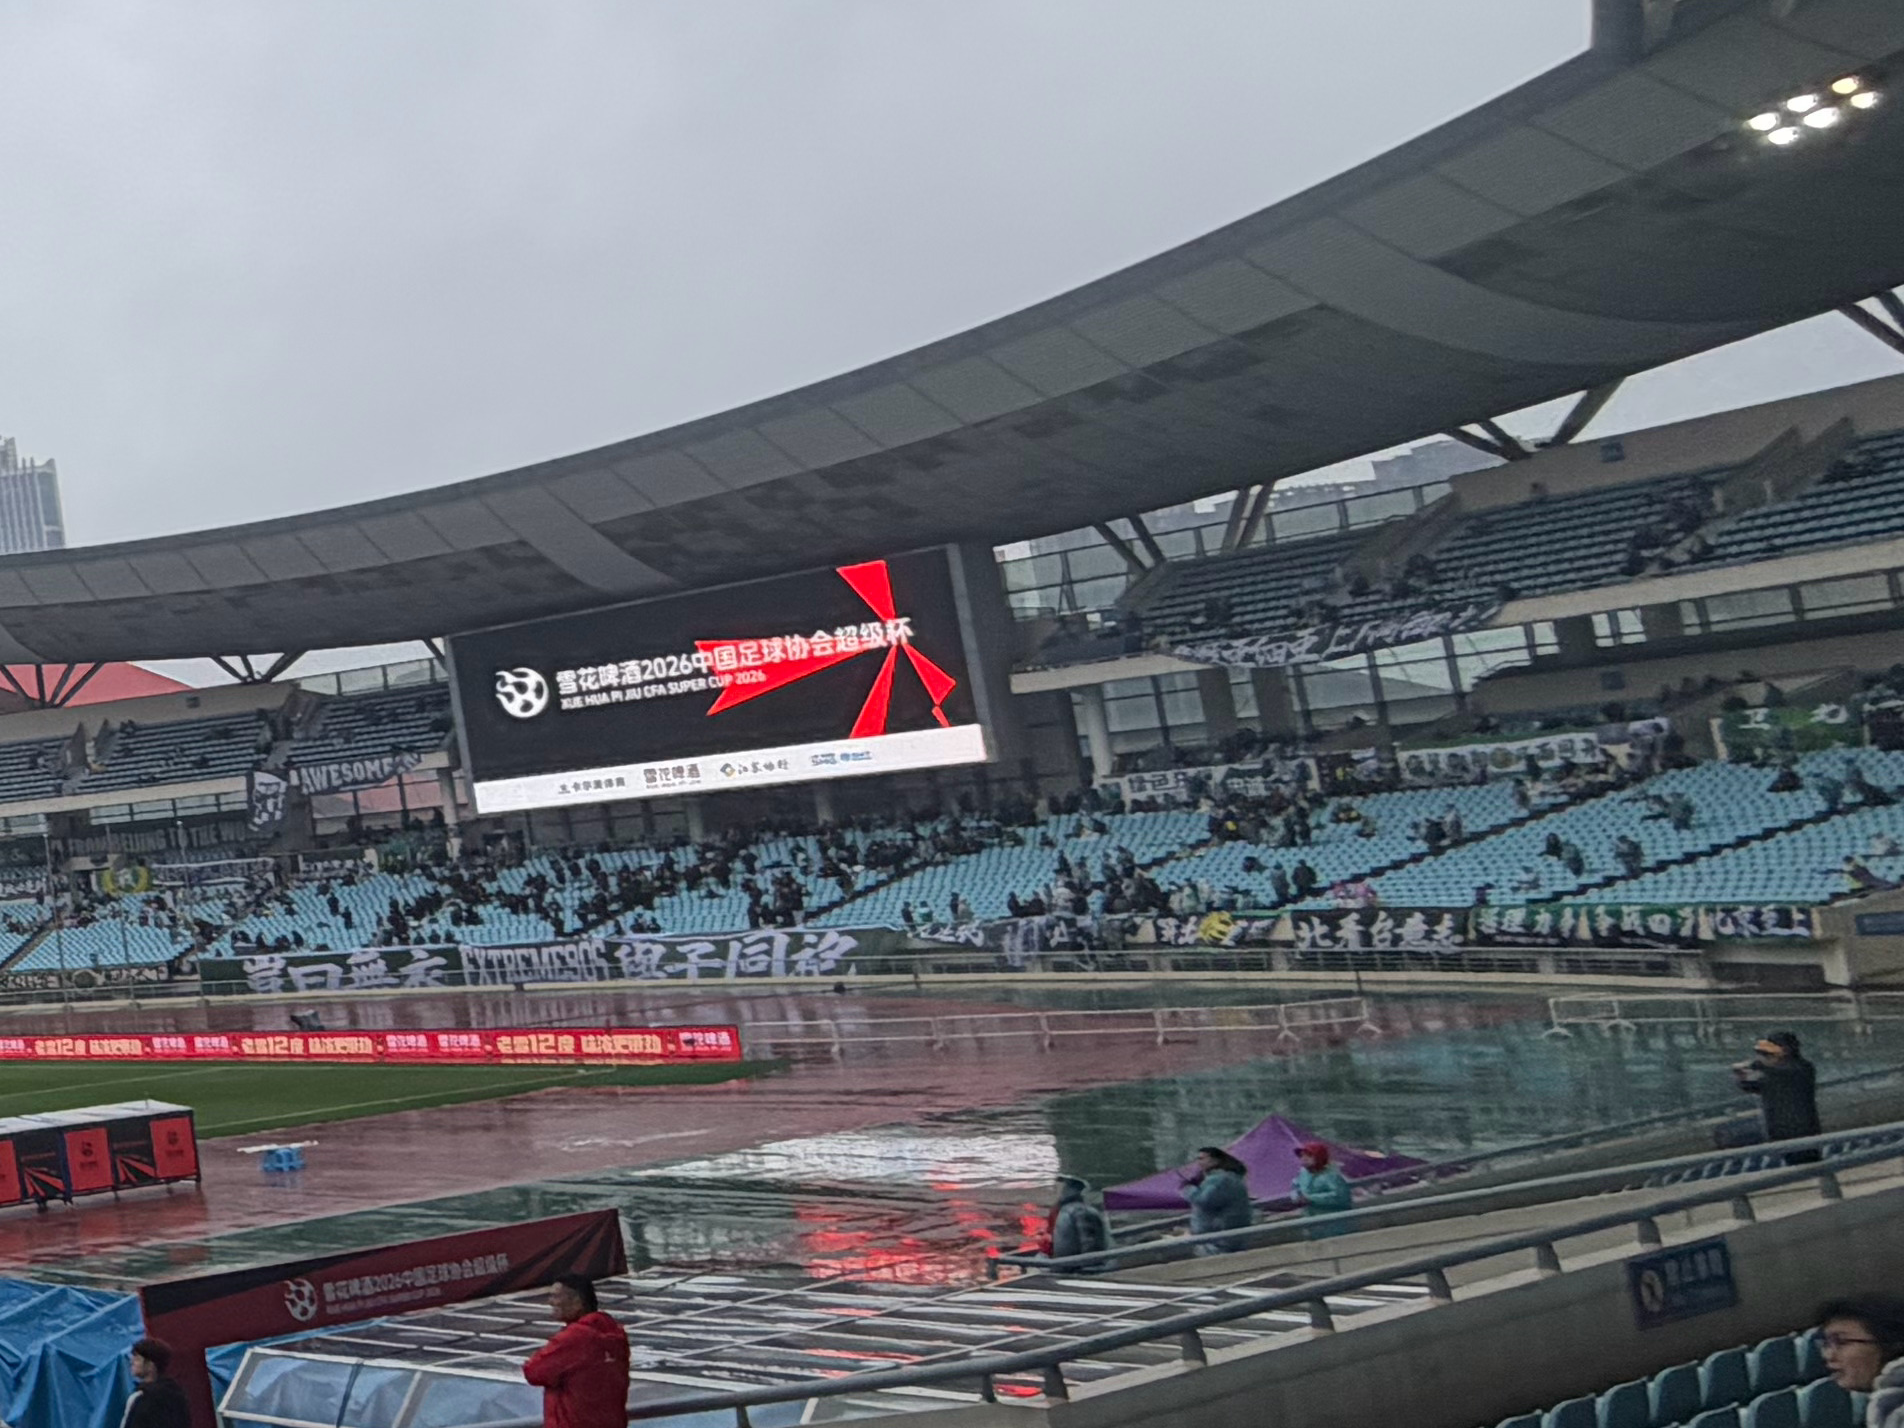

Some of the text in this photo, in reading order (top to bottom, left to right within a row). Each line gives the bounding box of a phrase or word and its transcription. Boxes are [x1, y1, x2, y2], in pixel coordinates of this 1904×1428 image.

[556, 616, 913, 695] 雪花啤酒2026中国足球协会超级杯
[668, 677, 706, 696] SUPER
[709, 673, 733, 690] CUP
[735, 669, 766, 686] 2026
